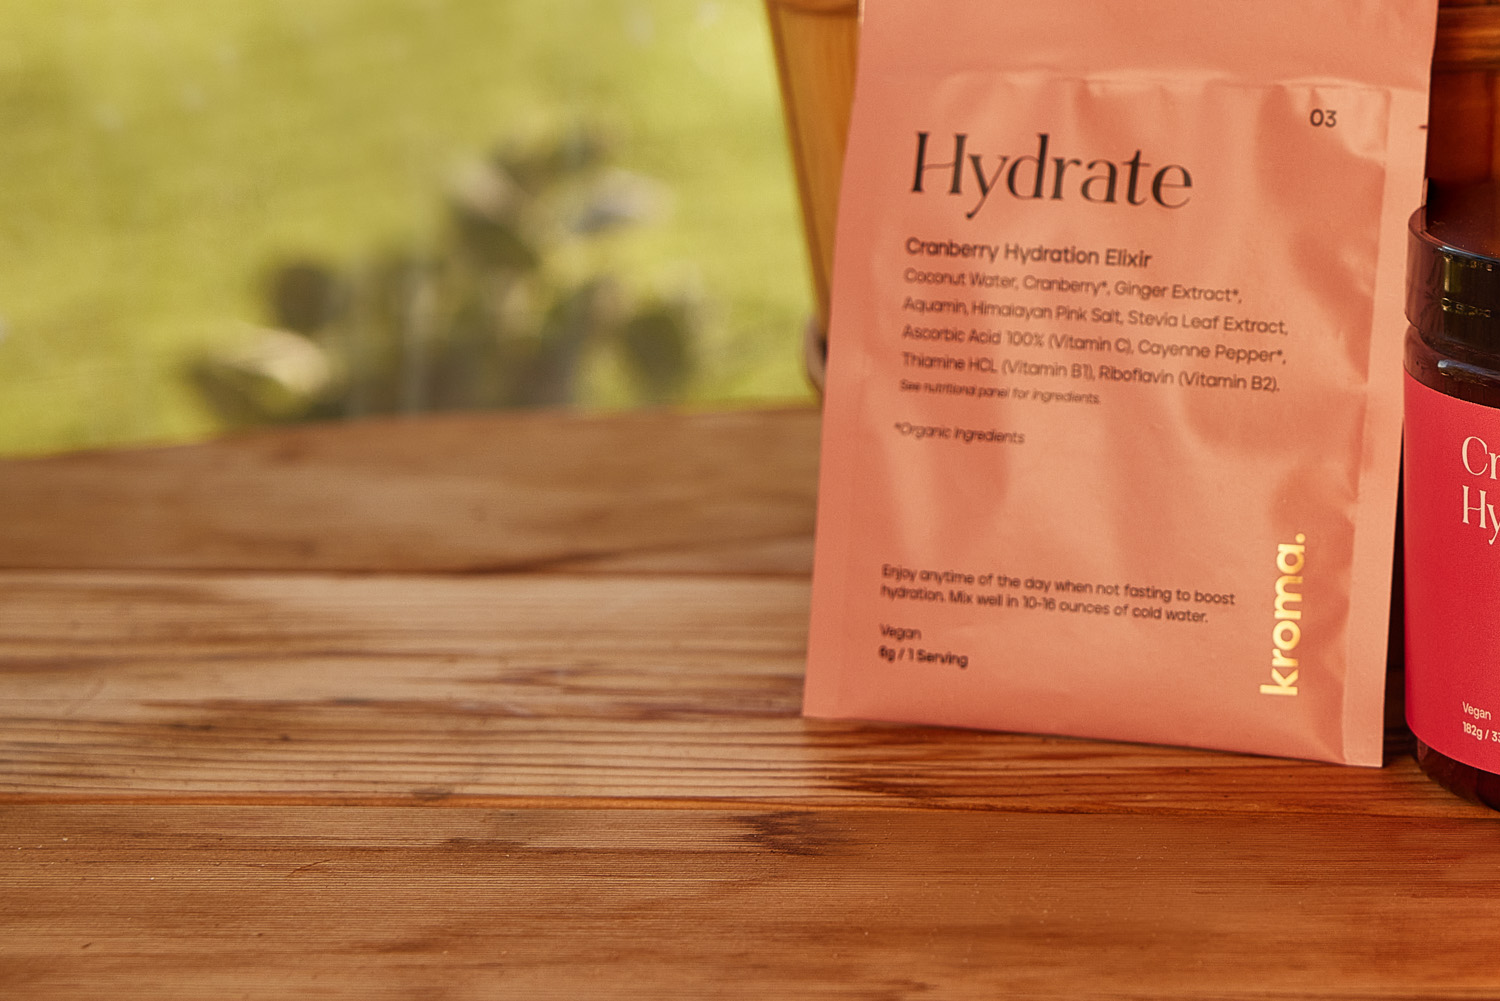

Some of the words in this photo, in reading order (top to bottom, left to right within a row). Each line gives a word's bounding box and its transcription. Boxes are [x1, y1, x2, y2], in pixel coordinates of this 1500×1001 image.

[1309, 108, 1337, 129] 03
[910, 130, 1194, 220] Hydrate
[905, 236, 999, 262] Cranberry
[1004, 243, 1099, 265] Hydration
[1105, 248, 1153, 268] Elixir
[903, 267, 966, 286] Coconut
[970, 273, 1020, 290] Water,
[1114, 280, 1168, 300] Ginger
[903, 296, 968, 315] Aquamin,
[971, 302, 1053, 320] Himalayan
[1056, 305, 1087, 320] Pink
[1091, 308, 1124, 325] Salt,
[1128, 310, 1178, 327] Stevia
[1181, 314, 1220, 330] Leaf
[1223, 316, 1289, 336] Extract,
[902, 324, 965, 342] Ascorbic
[968, 328, 1001, 344] Acid
[1006, 330, 1045, 346] 100%
[1049, 333, 1111, 352] (Vitamin
[1137, 339, 1211, 358] Cayenne
[901, 351, 966, 369] Thiamine
[1002, 359, 1067, 378] (Vitamin
[1099, 365, 1175, 384] Riboflavin
[1178, 371, 1247, 389] (Vitamin
[1251, 375, 1280, 393] B2).
[883, 563, 917, 582] Enjoy
[919, 569, 975, 588] anytime
[977, 572, 993, 587] of
[996, 573, 1021, 589] the
[1025, 576, 1052, 593] day
[1054, 578, 1093, 594] when
[1096, 581, 1120, 596] not
[1124, 584, 1173, 603] fasting
[1176, 588, 1191, 602] to
[1194, 589, 1236, 606] boost
[882, 584, 945, 603] hydration.
[949, 590, 973, 605] Mix
[976, 593, 1003, 607] well
[1006, 593, 1019, 608] in
[1022, 596, 1057, 611] 10-16
[1059, 600, 1110, 616] ounces
[1113, 602, 1130, 617] of
[1133, 604, 1163, 620] cold
[1165, 607, 1209, 623] water.
[1260, 533, 1306, 696] kroma.
[880, 624, 921, 641] Vegan
[917, 648, 969, 669] Serving
[1462, 701, 1491, 720] Vegan
[1462, 721, 1483, 741] 182g
[1485, 729, 1490, 740] /
